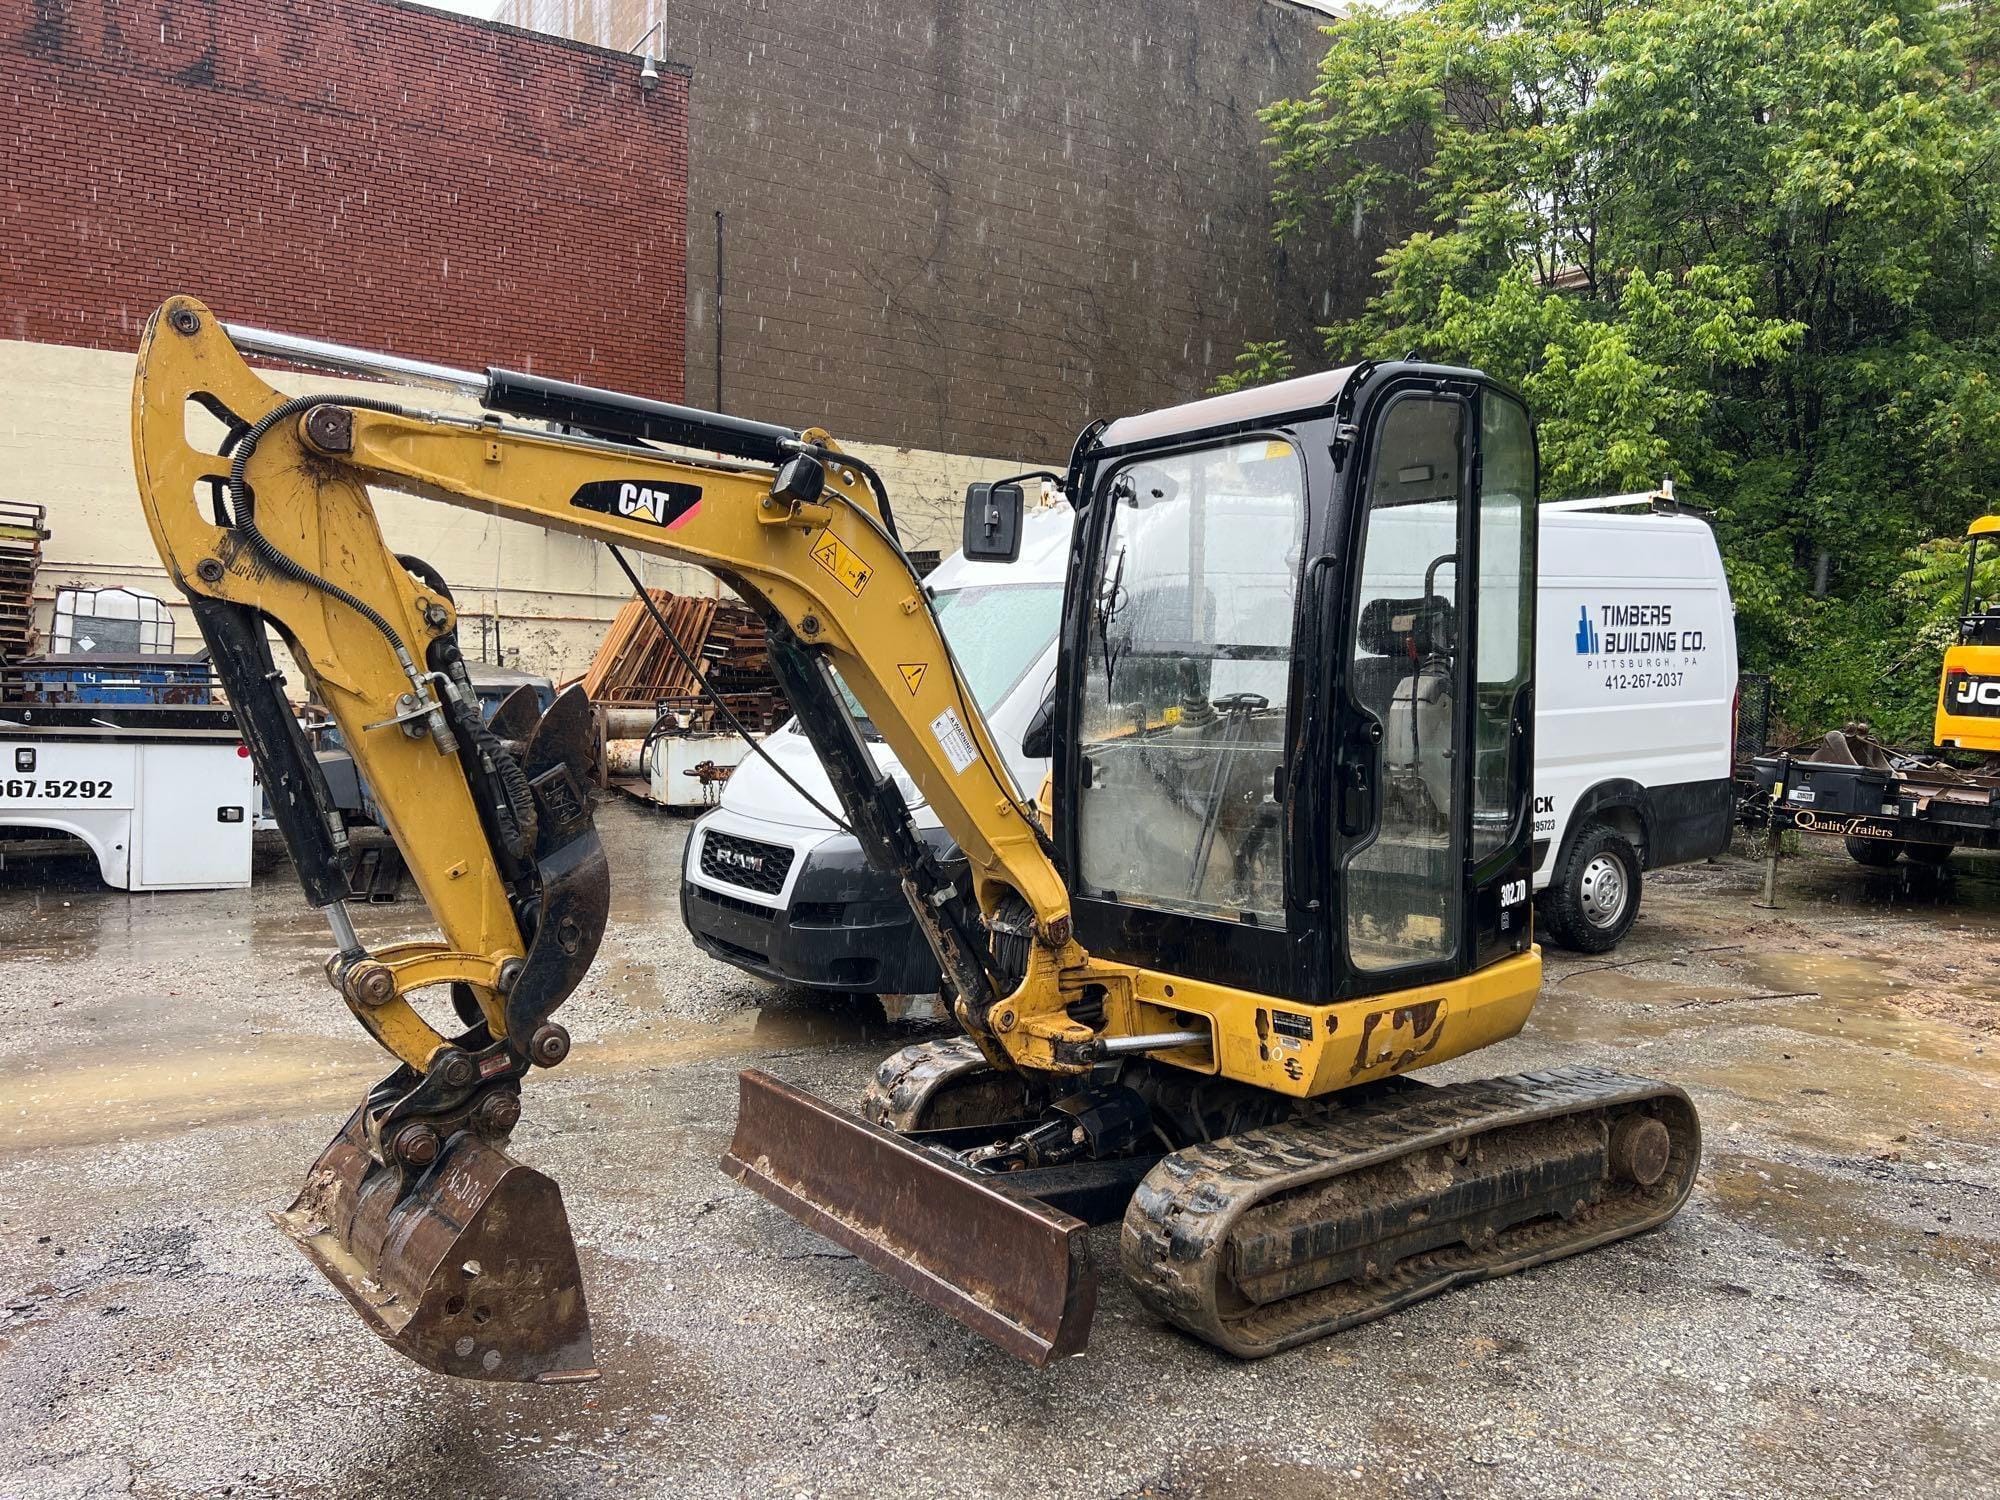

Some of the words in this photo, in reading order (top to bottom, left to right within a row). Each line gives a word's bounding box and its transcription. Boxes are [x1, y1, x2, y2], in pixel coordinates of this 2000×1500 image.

[618, 483, 669, 523] CAT
[1601, 605, 1671, 627] TIMBERS
[1605, 632, 1677, 653] BUILDING
[1684, 657, 1697, 667] PA
[83, 672, 96, 684] 14
[1605, 672, 1684, 689] 412-267-2037
[953, 721, 973, 754] WARNING
[0, 780, 113, 798] 67.5292
[1795, 810, 1848, 834] Quality
[1846, 817, 1893, 837] Trailers
[717, 848, 762, 872] RAM
[1501, 879, 1526, 907] 302.7D
